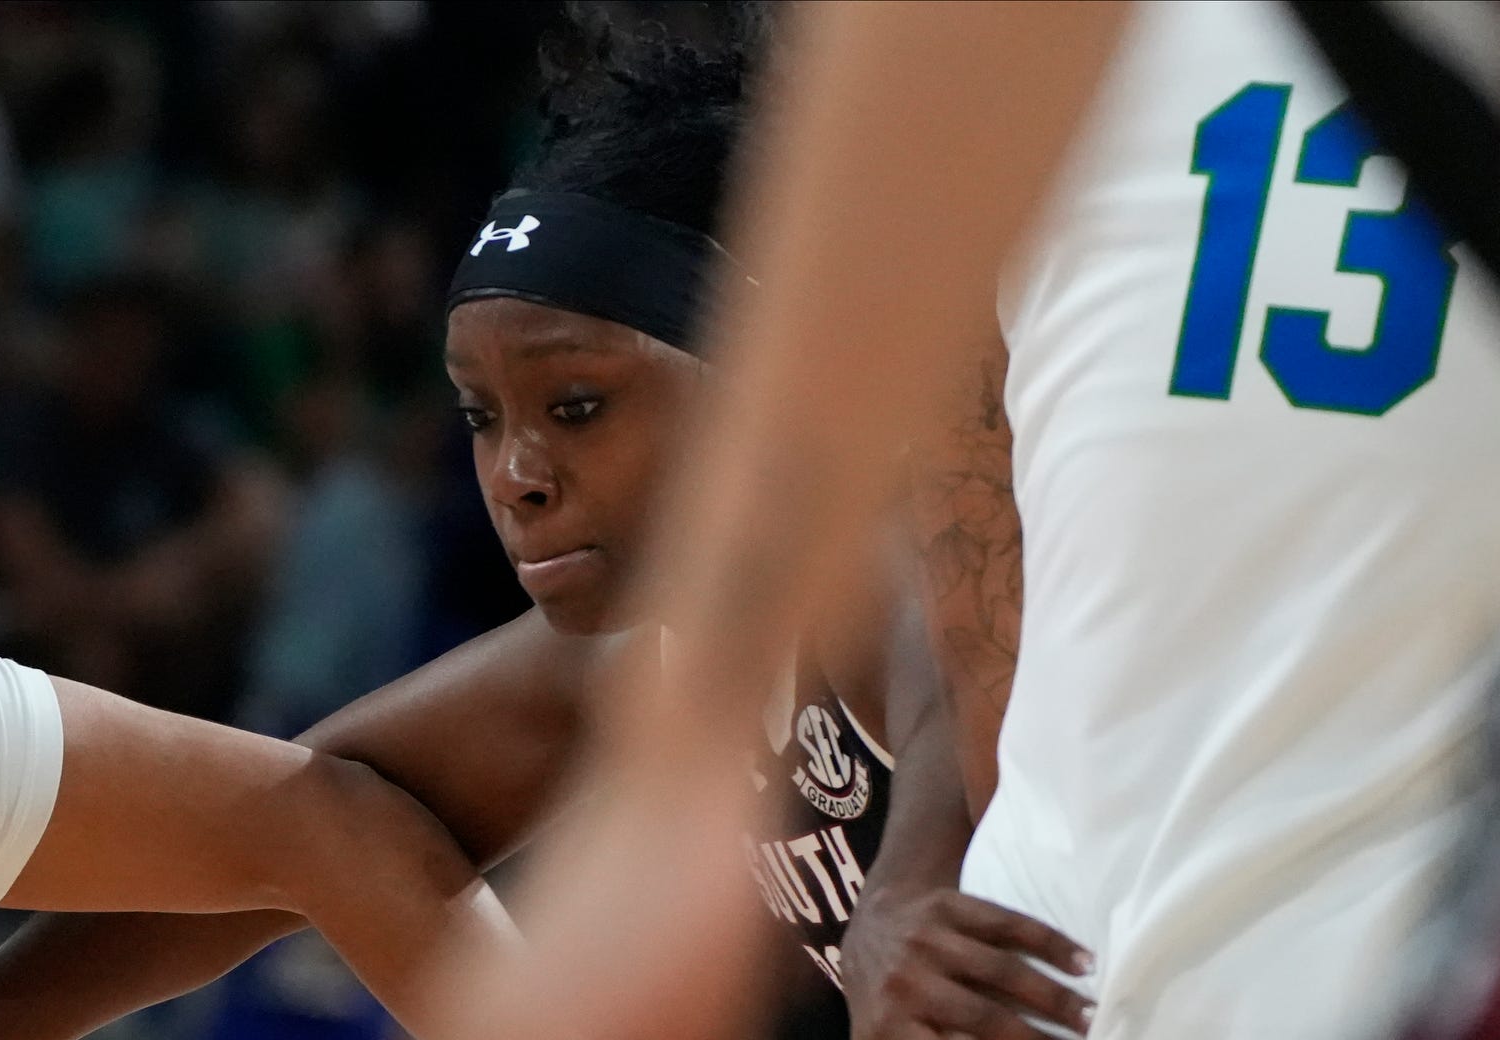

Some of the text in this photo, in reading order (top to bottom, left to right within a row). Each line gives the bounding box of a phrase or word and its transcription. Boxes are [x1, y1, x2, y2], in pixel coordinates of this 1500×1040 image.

[1168, 81, 1460, 418] 13
[807, 782, 868, 818] GRADUATE
[750, 825, 866, 924] OUTH
